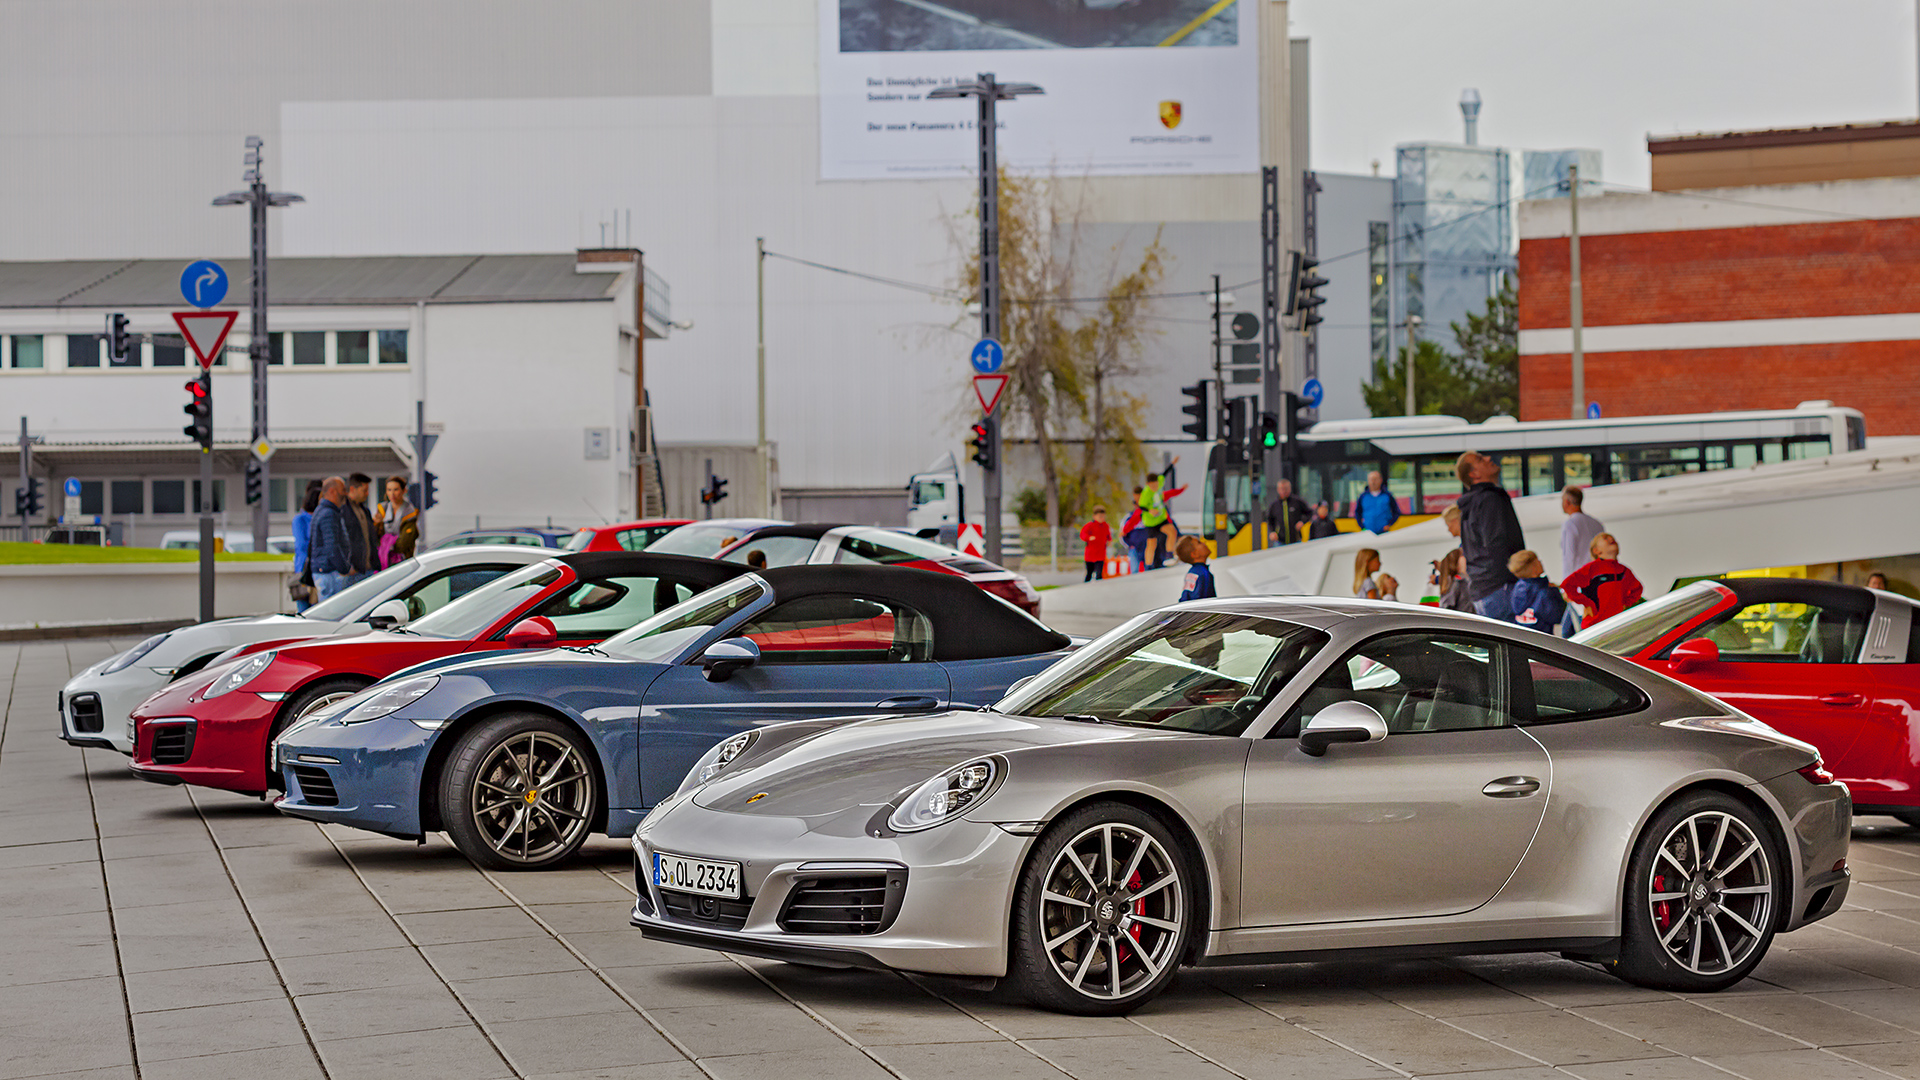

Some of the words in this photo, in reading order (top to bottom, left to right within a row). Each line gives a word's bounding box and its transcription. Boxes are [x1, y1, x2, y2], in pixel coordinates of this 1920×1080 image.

[867, 77, 883, 86] Das
[867, 92, 902, 101] Sondern
[867, 122, 882, 131] Der
[886, 122, 907, 131] neue
[910, 121, 955, 131] Panamera
[1130, 135, 1212, 144] PORSCHE
[660, 858, 668, 884] S
[676, 861, 694, 887] OL
[697, 863, 736, 894] 2334
